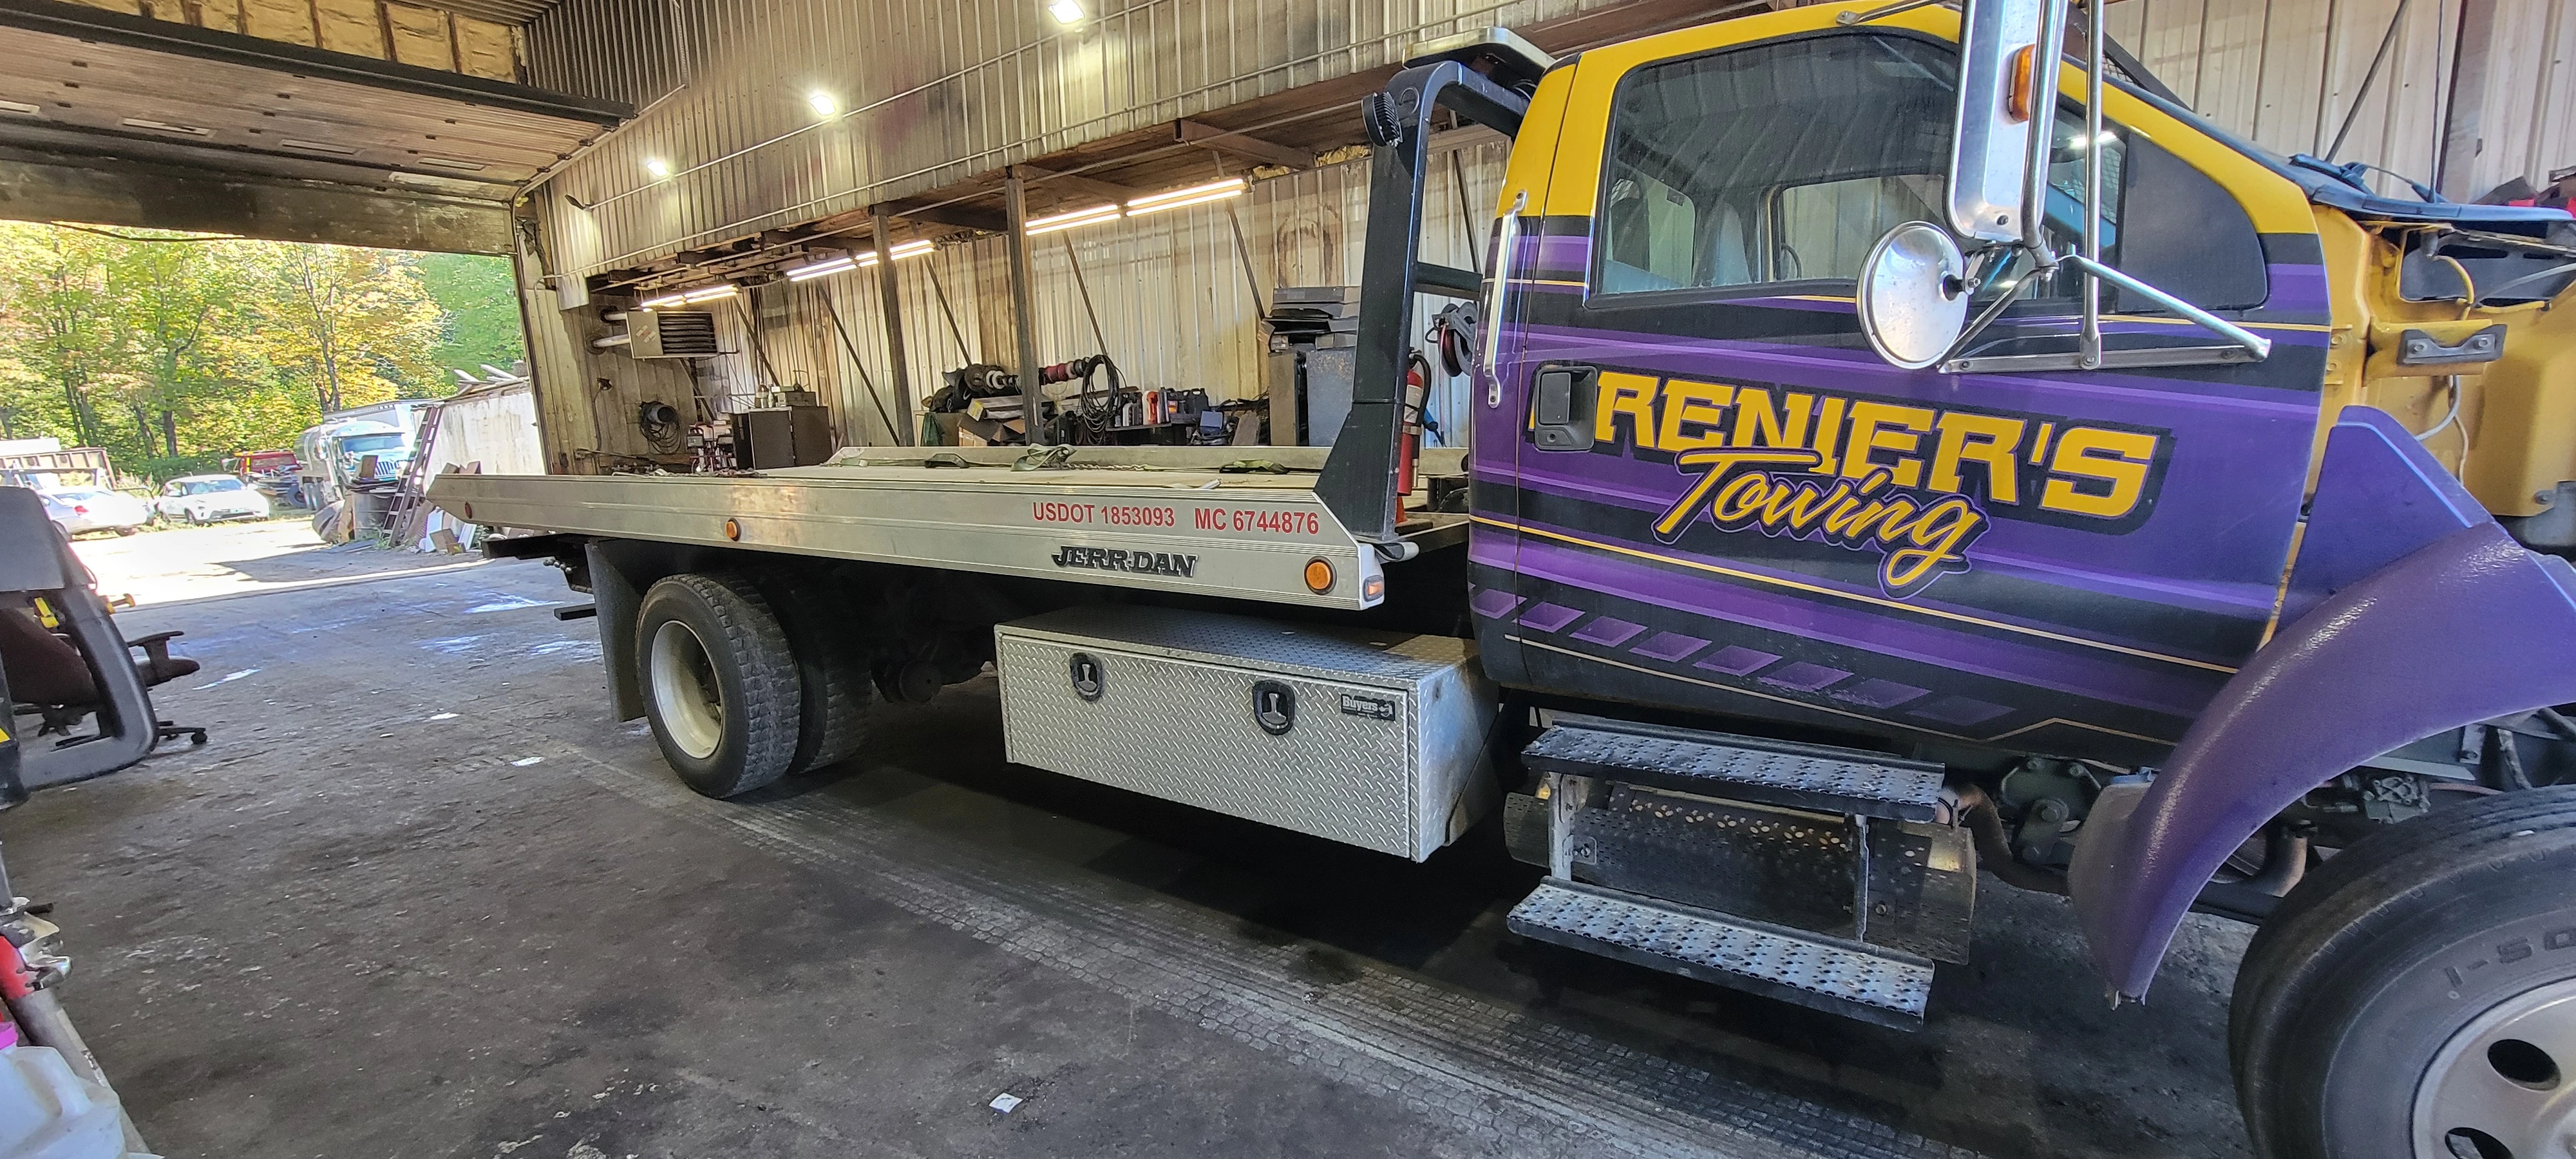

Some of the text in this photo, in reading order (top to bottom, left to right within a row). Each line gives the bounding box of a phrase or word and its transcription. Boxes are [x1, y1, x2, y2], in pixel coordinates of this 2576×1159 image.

[1528, 372, 2157, 517] RENIER'S
[1033, 502, 1319, 534] USDOT 1853093 MC 6744876
[1654, 452, 1981, 586] Towing
[1342, 696, 1378, 711] Buyers
